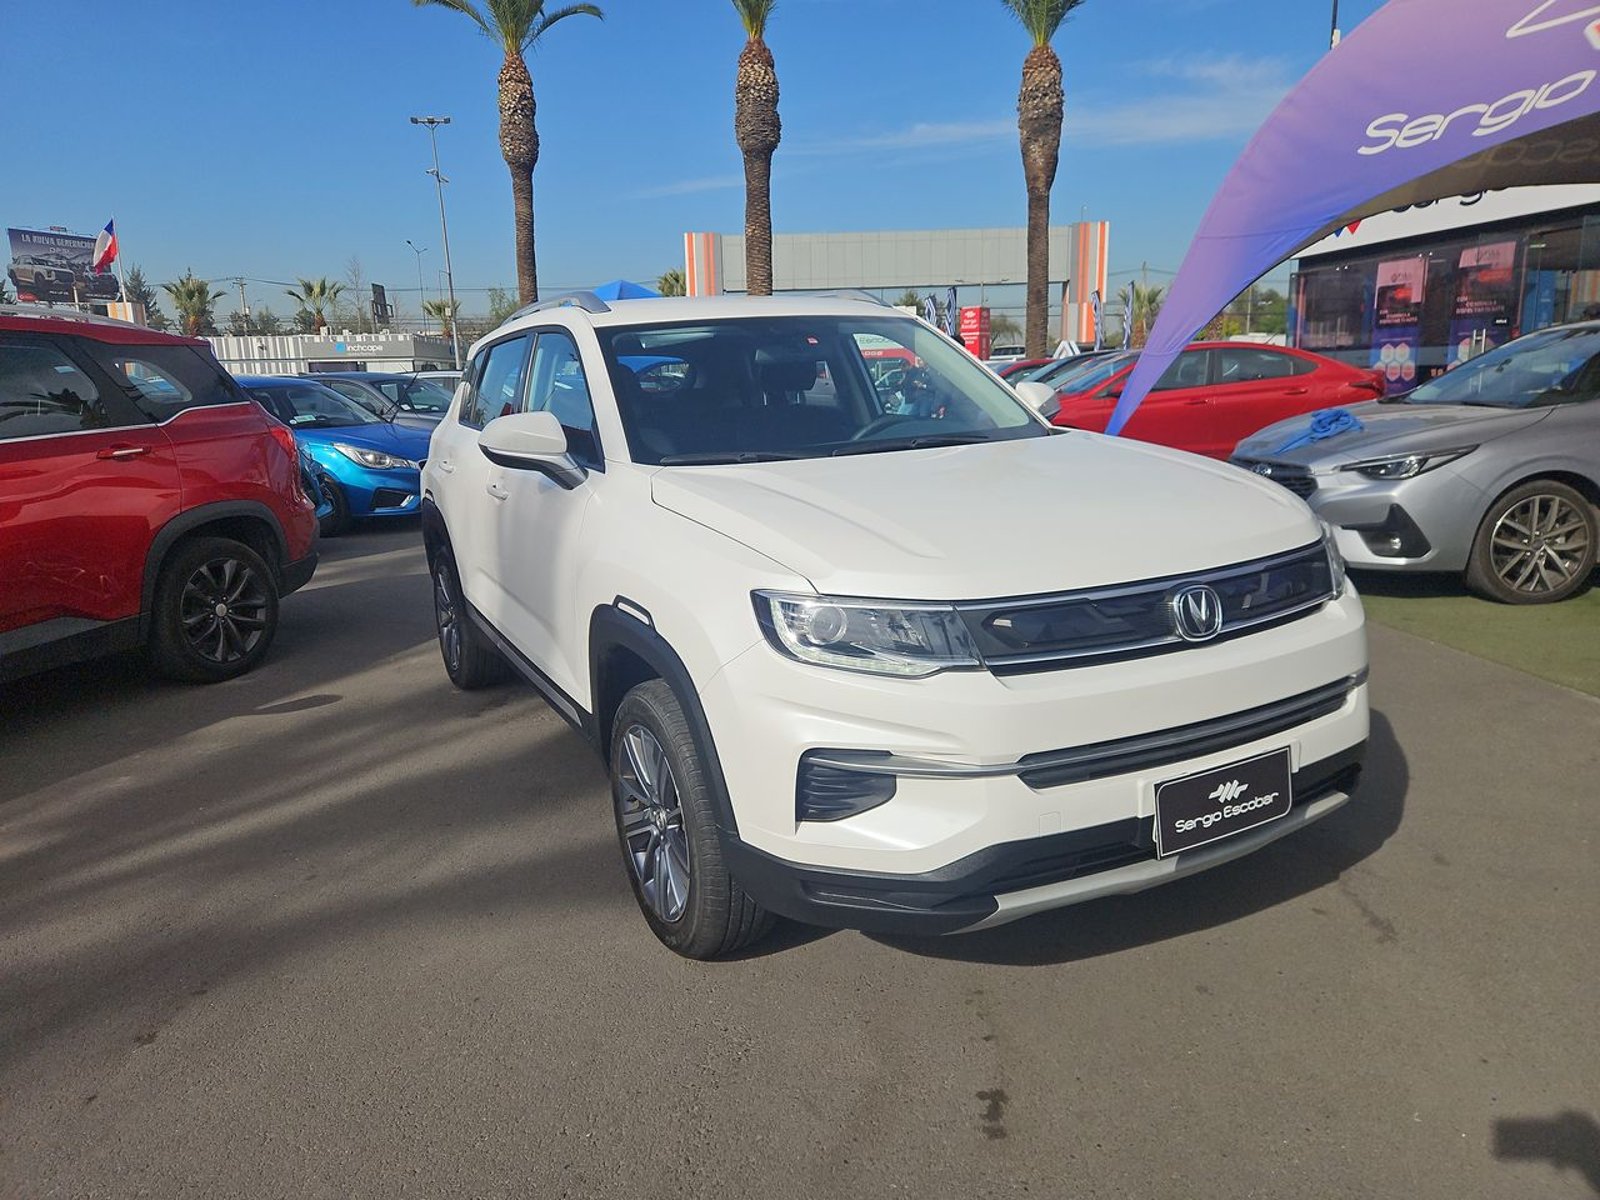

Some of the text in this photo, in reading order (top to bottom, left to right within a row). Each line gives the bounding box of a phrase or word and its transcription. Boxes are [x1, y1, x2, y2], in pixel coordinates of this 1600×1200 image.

[1357, 69, 1598, 156] Sergio
[1174, 792, 1280, 833] Sergio Escobar
